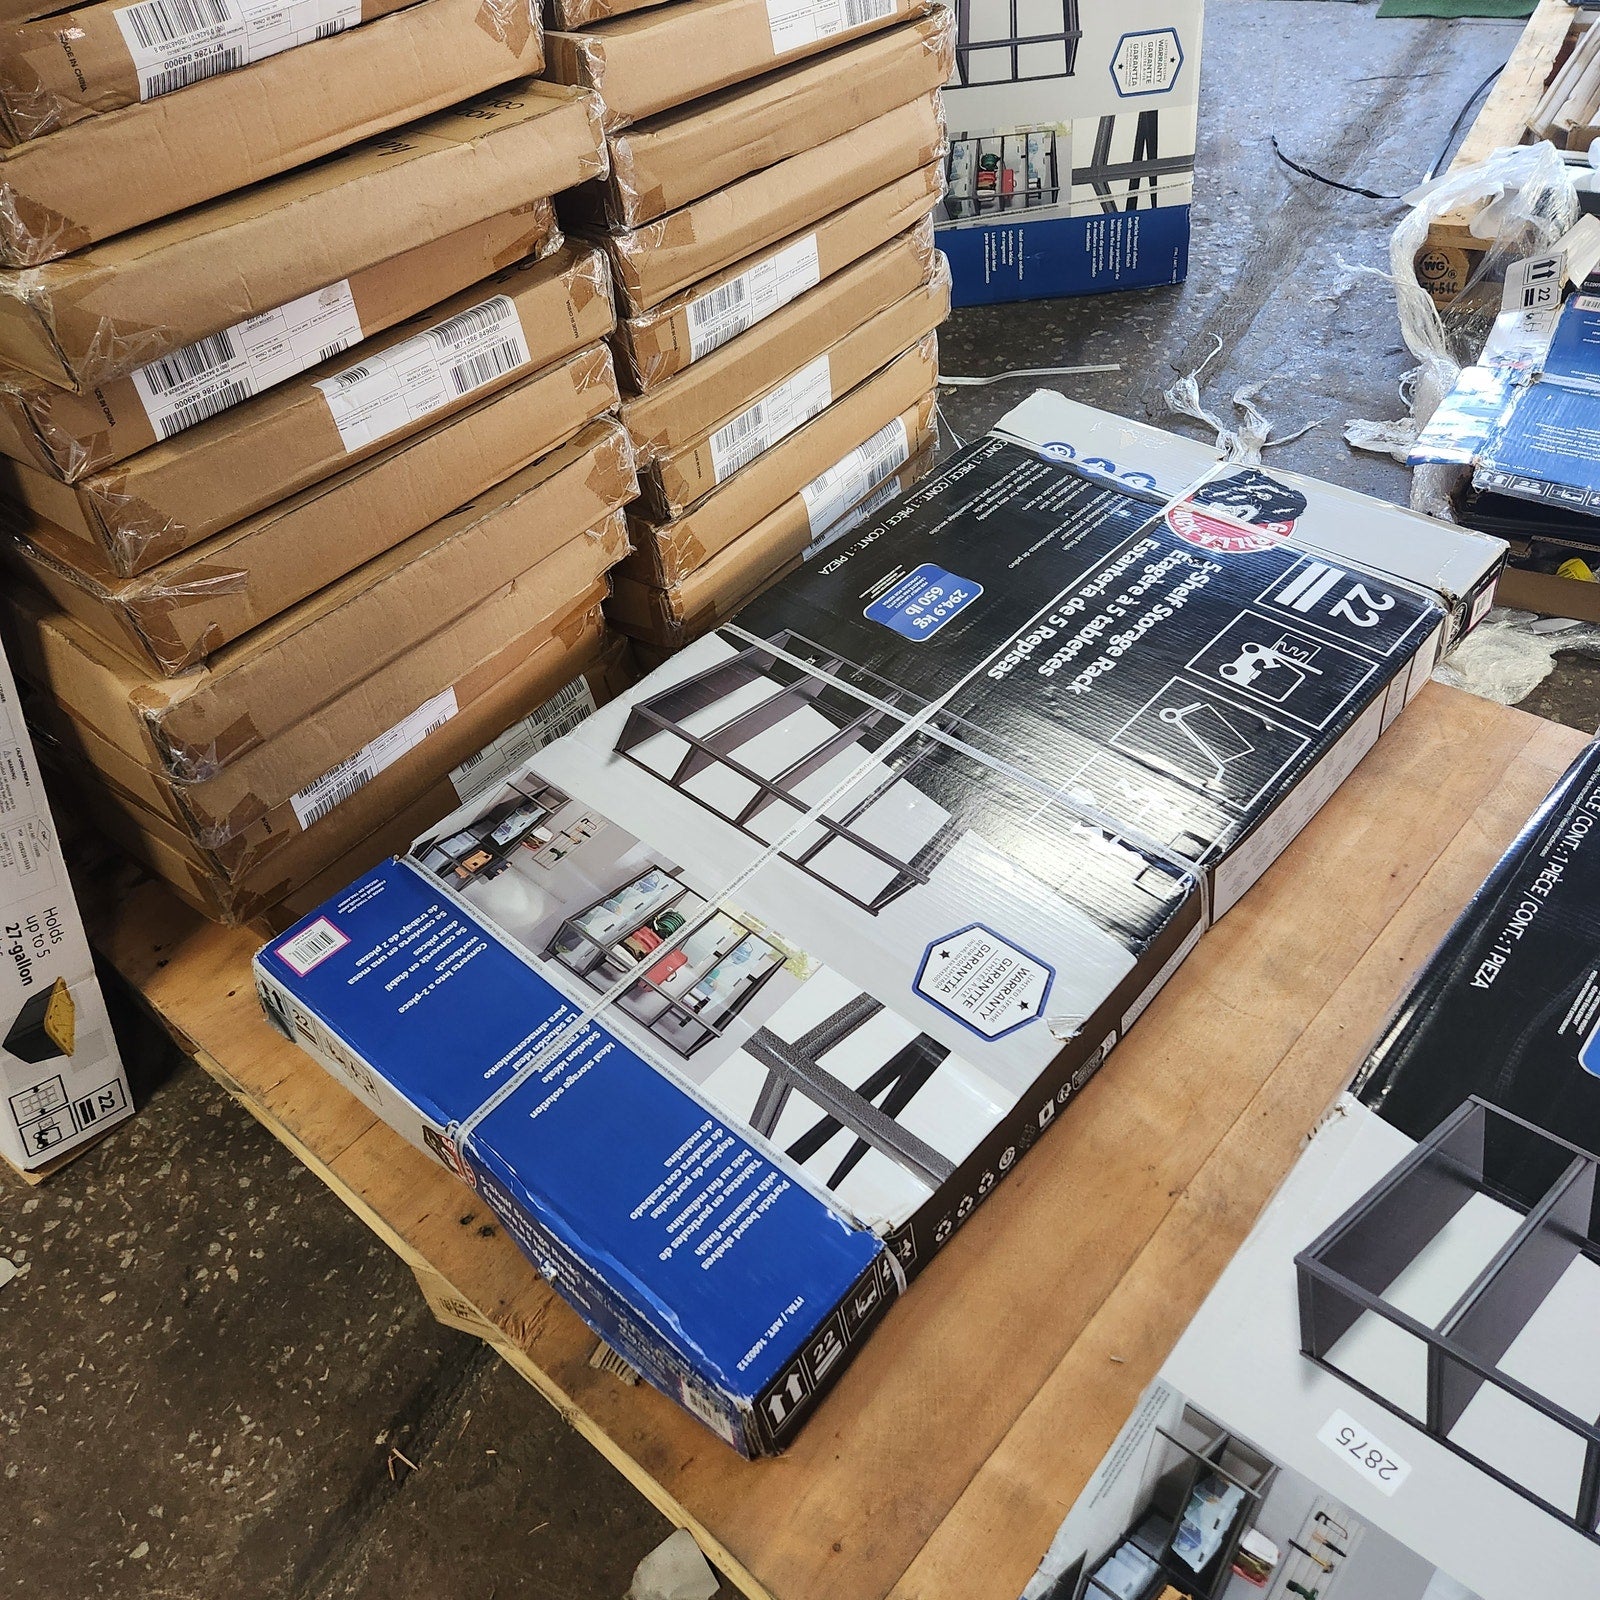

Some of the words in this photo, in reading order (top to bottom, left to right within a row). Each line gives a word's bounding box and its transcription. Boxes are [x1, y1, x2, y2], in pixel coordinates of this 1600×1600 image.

[163, 53, 192, 70] 849000
[193, 42, 224, 59] M71286
[1155, 38, 1163, 83] WARRANTY
[1145, 41, 1153, 84] GARANTIE
[1537, 286, 1550, 302] 22
[452, 333, 480, 350] M71286
[476, 322, 502, 339] 849000
[199, 377, 232, 397] M71286
[171, 391, 202, 410] 849000
[1079, 538, 1160, 597] Estantería
[1127, 548, 1192, 595] Étagère
[917, 586, 943, 605] 650
[1164, 560, 1222, 608] 5-Shelf
[904, 603, 924, 615] lb
[933, 588, 968, 616] 294.9
[1058, 596, 1085, 615] de
[1105, 603, 1126, 617] 5
[1114, 594, 1140, 605] à
[1328, 583, 1394, 627] 22
[912, 613, 938, 629] kg
[1047, 614, 1068, 628] 5
[1106, 603, 1172, 656] Storage
[987, 625, 1056, 679] Repisas
[1038, 614, 1113, 676] tablettes
[1065, 656, 1116, 696] Rack
[1530, 861, 1563, 896] PIÈCE
[426, 904, 438, 914] de
[434, 910, 447, 920] Se
[24, 914, 39, 933] up
[42, 906, 64, 944] Holds
[397, 918, 435, 948] convierte
[398, 912, 428, 935] trabajo
[437, 919, 458, 936] deux
[454, 925, 467, 936] Se
[31, 932, 44, 948] to
[380, 940, 389, 948] 2
[387, 933, 399, 943] de
[412, 933, 439, 956] pièces
[418, 934, 455, 964] convertit
[6, 922, 33, 987] 27-gallon
[35, 948, 51, 958] 5
[354, 944, 382, 966] piezas
[369, 954, 388, 968] una
[386, 946, 398, 956] en
[434, 936, 479, 971] workbench
[450, 942, 487, 971] Converts
[347, 966, 371, 984] mesa
[407, 961, 420, 972] en
[434, 969, 453, 984] into
[940, 943, 990, 993] GARANTÍA
[1470, 951, 1506, 988] PIEZA
[384, 970, 409, 991] établi
[960, 986, 973, 998] VIE
[962, 957, 1012, 1008] GARANTIE
[1012, 973, 1035, 997] LIMITED
[397, 987, 430, 1013] 2-piece
[979, 967, 1030, 1020] WARRANTY
[547, 1003, 568, 1022] para
[564, 1012, 580, 1025] La
[988, 996, 1015, 1022] LIFETIME
[532, 1021, 569, 1051] solución
[576, 1022, 593, 1036] de
[483, 1021, 549, 1078] almacenamiento
[565, 1030, 600, 1061] Solution
[592, 1041, 615, 1062] Ideal
[511, 1047, 537, 1071] ideal
[541, 1059, 569, 1083] idéale
[562, 1059, 594, 1088] storage
[97, 1090, 115, 1113] 22
[529, 1086, 564, 1118] solution
[699, 1119, 712, 1132] de
[710, 1127, 723, 1140] de
[663, 1130, 702, 1167] melanina
[679, 1138, 712, 1170] madera
[701, 1136, 735, 1168] Repisas
[730, 1148, 752, 1168] bois
[663, 1168, 682, 1185] con
[689, 1165, 703, 1179] de
[719, 1165, 733, 1179] au
[722, 1159, 762, 1196] Tablettes
[756, 1171, 778, 1191] with
[650, 1175, 692, 1219] partículas
[705, 1177, 724, 1195] fini
[755, 1179, 790, 1212] Particle
[629, 1183, 666, 1219] acabado
[665, 1191, 708, 1233] mélamine
[710, 1194, 724, 1207] en
[717, 1189, 759, 1231] melamine
[670, 1203, 713, 1248] particules
[731, 1210, 760, 1239] board
[658, 1246, 672, 1260] de
[694, 1229, 722, 1255] finish
[700, 1235, 734, 1269] shelves
[784, 1295, 804, 1314] ITM.
[764, 1317, 783, 1338] ART.
[779, 1311, 788, 1322] /
[736, 1337, 767, 1371] 1600212
[813, 1330, 835, 1363] 22
[1334, 1425, 1398, 1481] 2875
